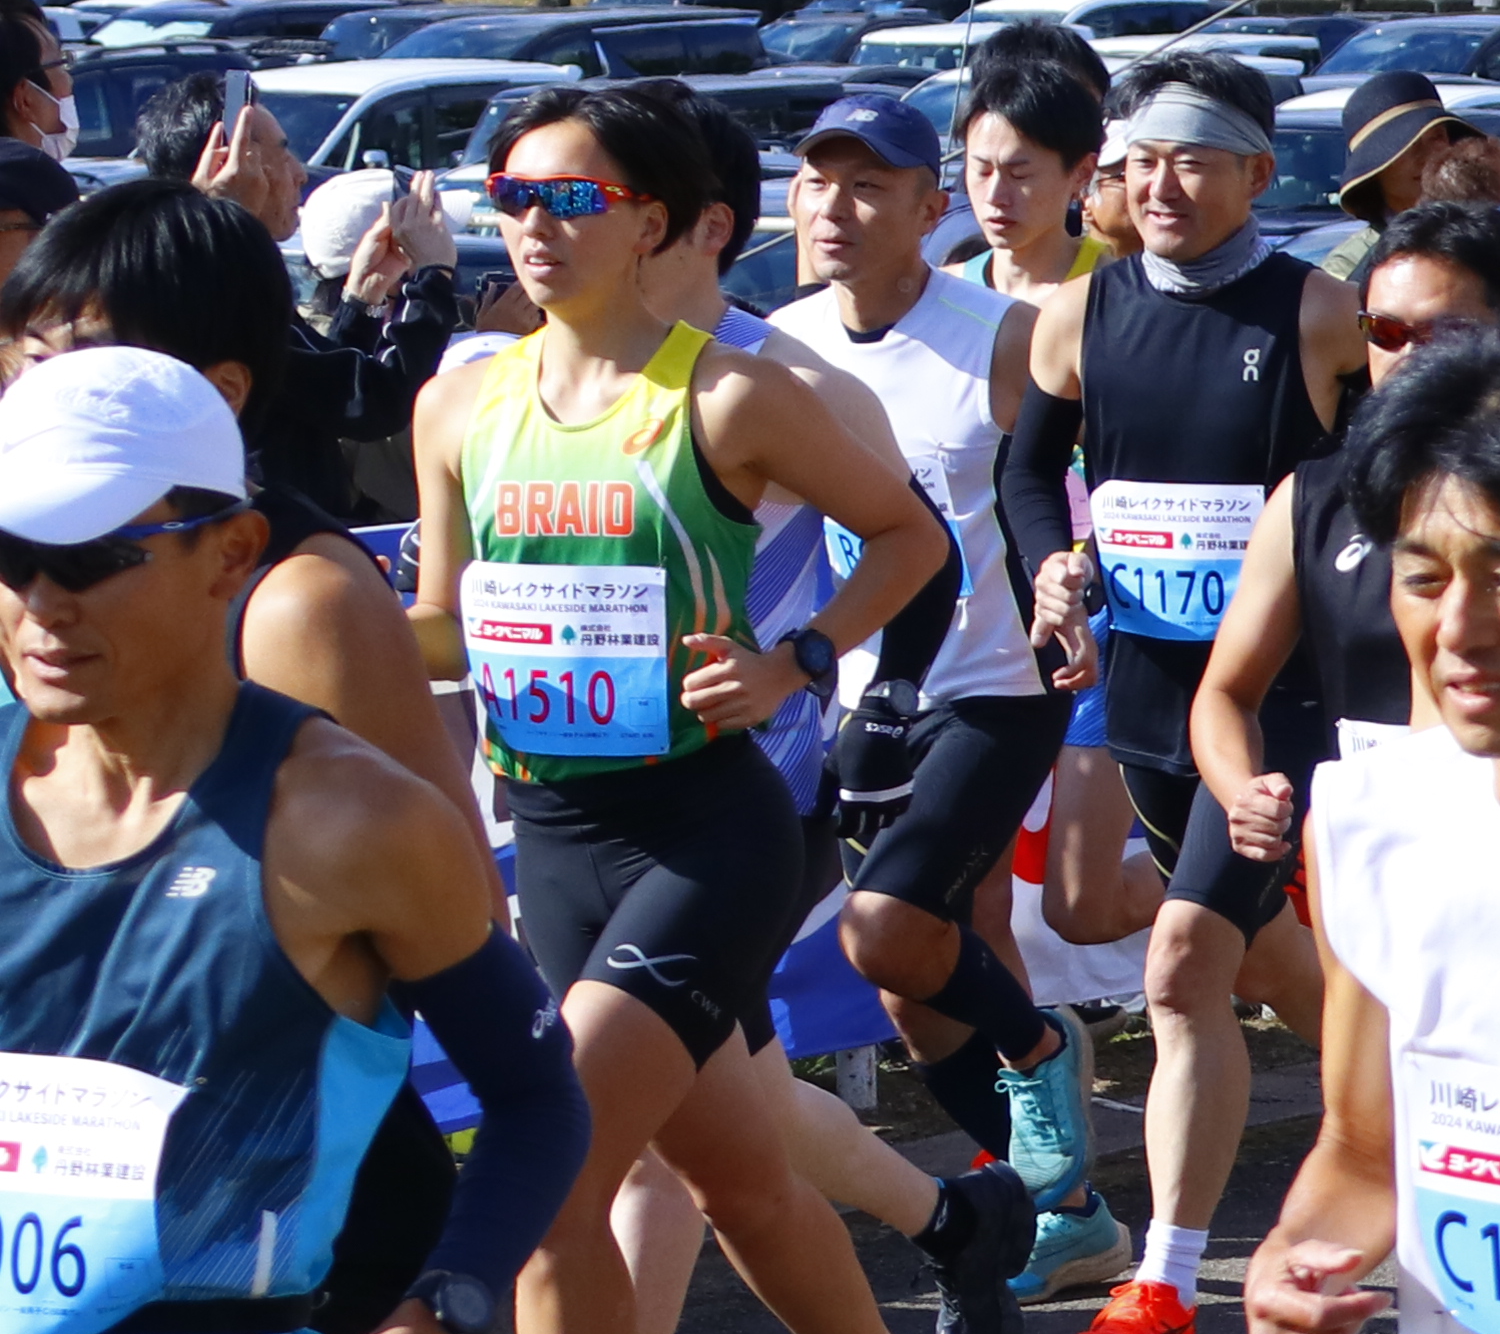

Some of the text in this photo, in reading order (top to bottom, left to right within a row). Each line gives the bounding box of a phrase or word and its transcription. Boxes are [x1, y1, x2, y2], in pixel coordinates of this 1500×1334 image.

[496, 480, 636, 537] BRAID
[1102, 495, 1251, 512] 川崎レイクサイドマラソン
[472, 578, 648, 599] 川崎レイクサイドマラソン
[1110, 563, 1225, 616] C1170
[491, 601, 537, 612] KAWASAKI
[539, 603, 586, 613] LAKESIDE
[589, 604, 648, 613] MARATHON
[483, 624, 544, 640] ヨークベニマル
[580, 633, 660, 646] 丹野林業建設
[482, 662, 616, 726] A1510
[1431, 1112, 1462, 1129] 2024
[0, 1212, 86, 1298] 06
